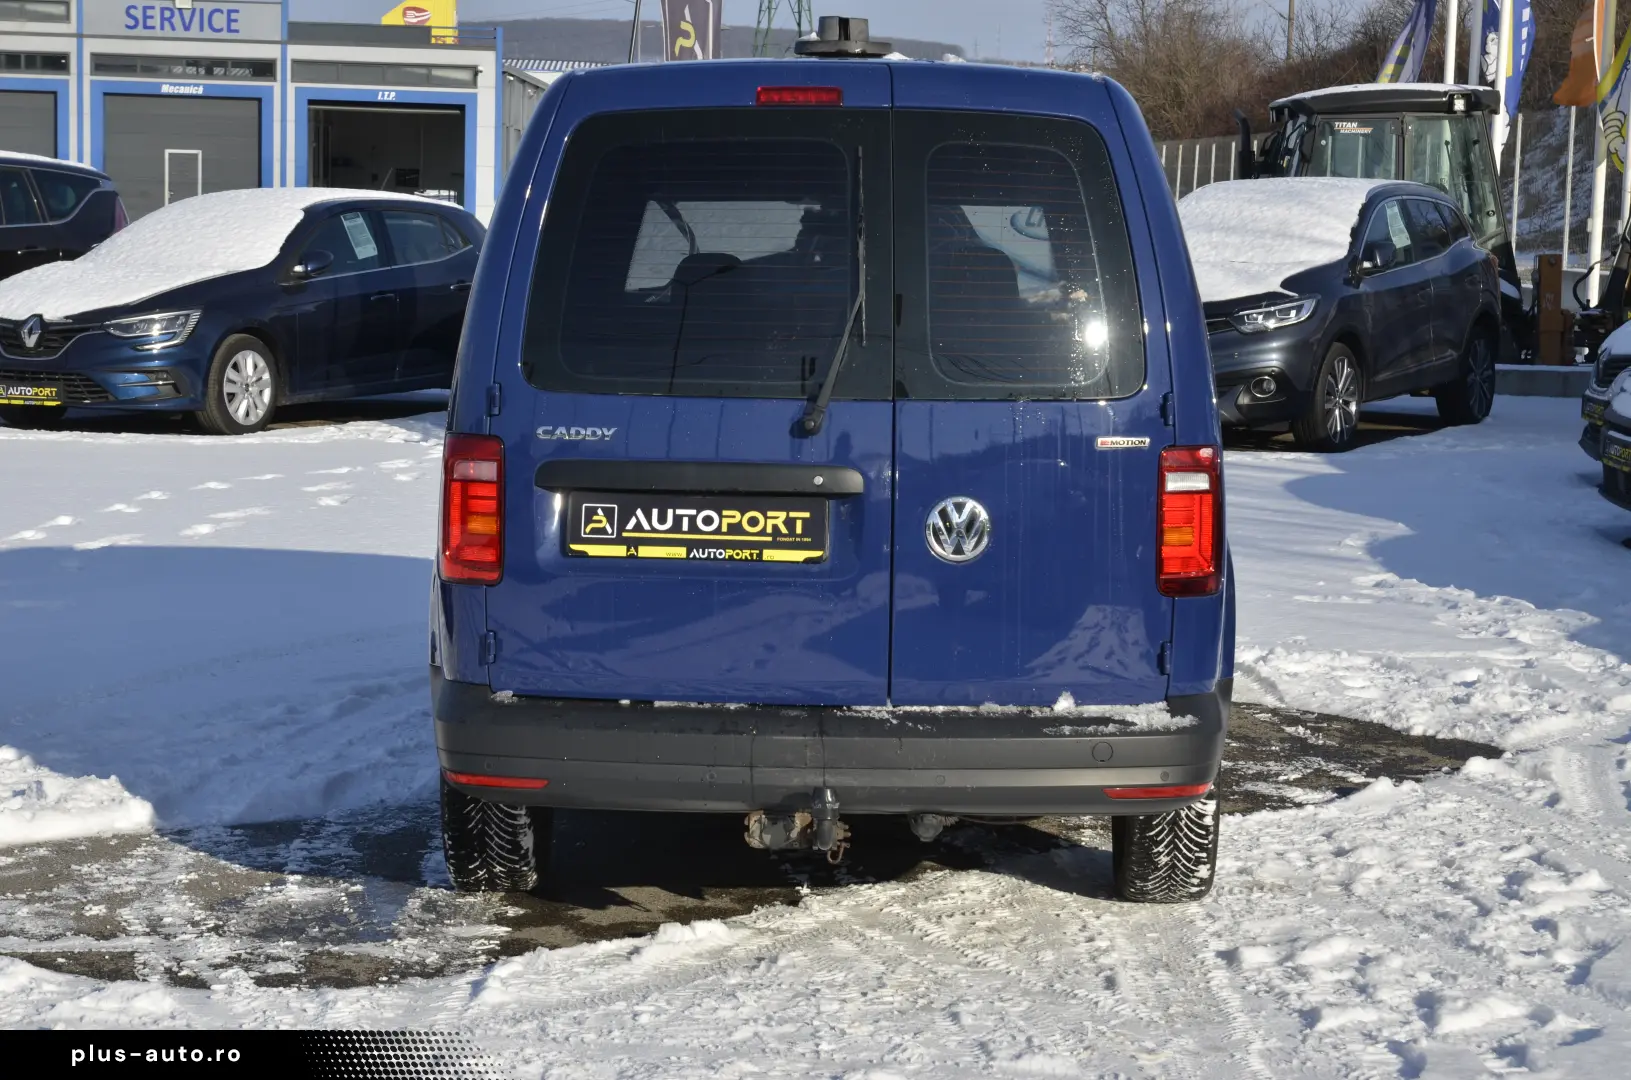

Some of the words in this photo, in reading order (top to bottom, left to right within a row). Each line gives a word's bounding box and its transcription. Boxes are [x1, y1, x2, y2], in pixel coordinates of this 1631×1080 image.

[125, 4, 240, 34] SERVICE
[8, 386, 57, 397] AUTOPORT
[536, 425, 617, 440] CADDY
[625, 507, 811, 534] AUTOPORT
